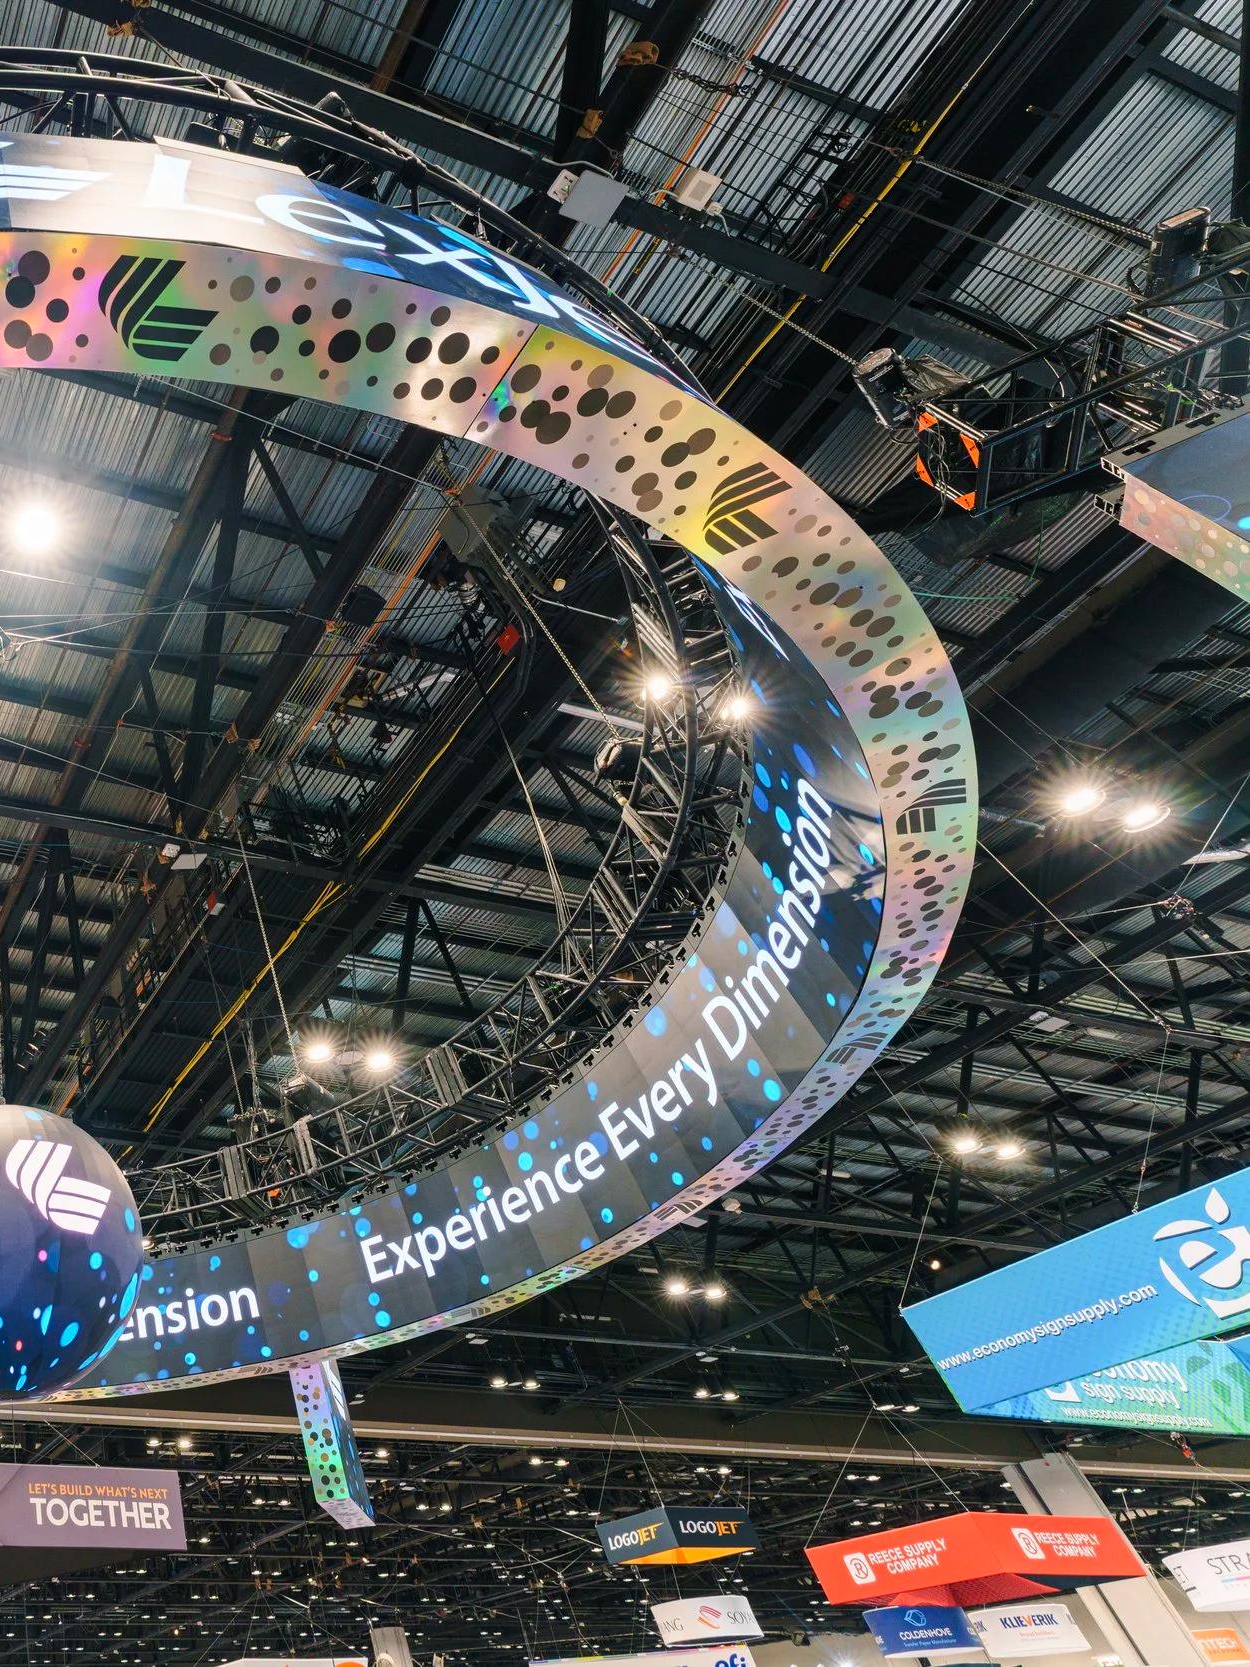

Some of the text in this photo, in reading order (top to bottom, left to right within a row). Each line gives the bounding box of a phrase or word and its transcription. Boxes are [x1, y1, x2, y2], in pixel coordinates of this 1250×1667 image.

[360, 776, 837, 1285] Experience Every Dimension
[118, 1286, 261, 1342] nsion
[937, 1283, 1159, 1371] www.economysignsupply.com
[1080, 1378, 1181, 1410] sign supply
[1061, 1406, 1214, 1429] www.economysignsupply.com
[28, 1482, 168, 1500] LET'S BUILD WHAT'S NEXT
[30, 1498, 172, 1530] TOGETHER
[608, 1522, 663, 1550] LOGOJET
[679, 1520, 746, 1536] LOGOJET
[1035, 1531, 1101, 1546] REECE SUPPLY
[868, 1538, 947, 1566] REECE SUPPLY
[1053, 1545, 1097, 1558] COMPANY
[886, 1554, 940, 1575] COMPANY
[1000, 1613, 1058, 1629] KLIEVERIK
[899, 1627, 953, 1640] COLDENHOVE
